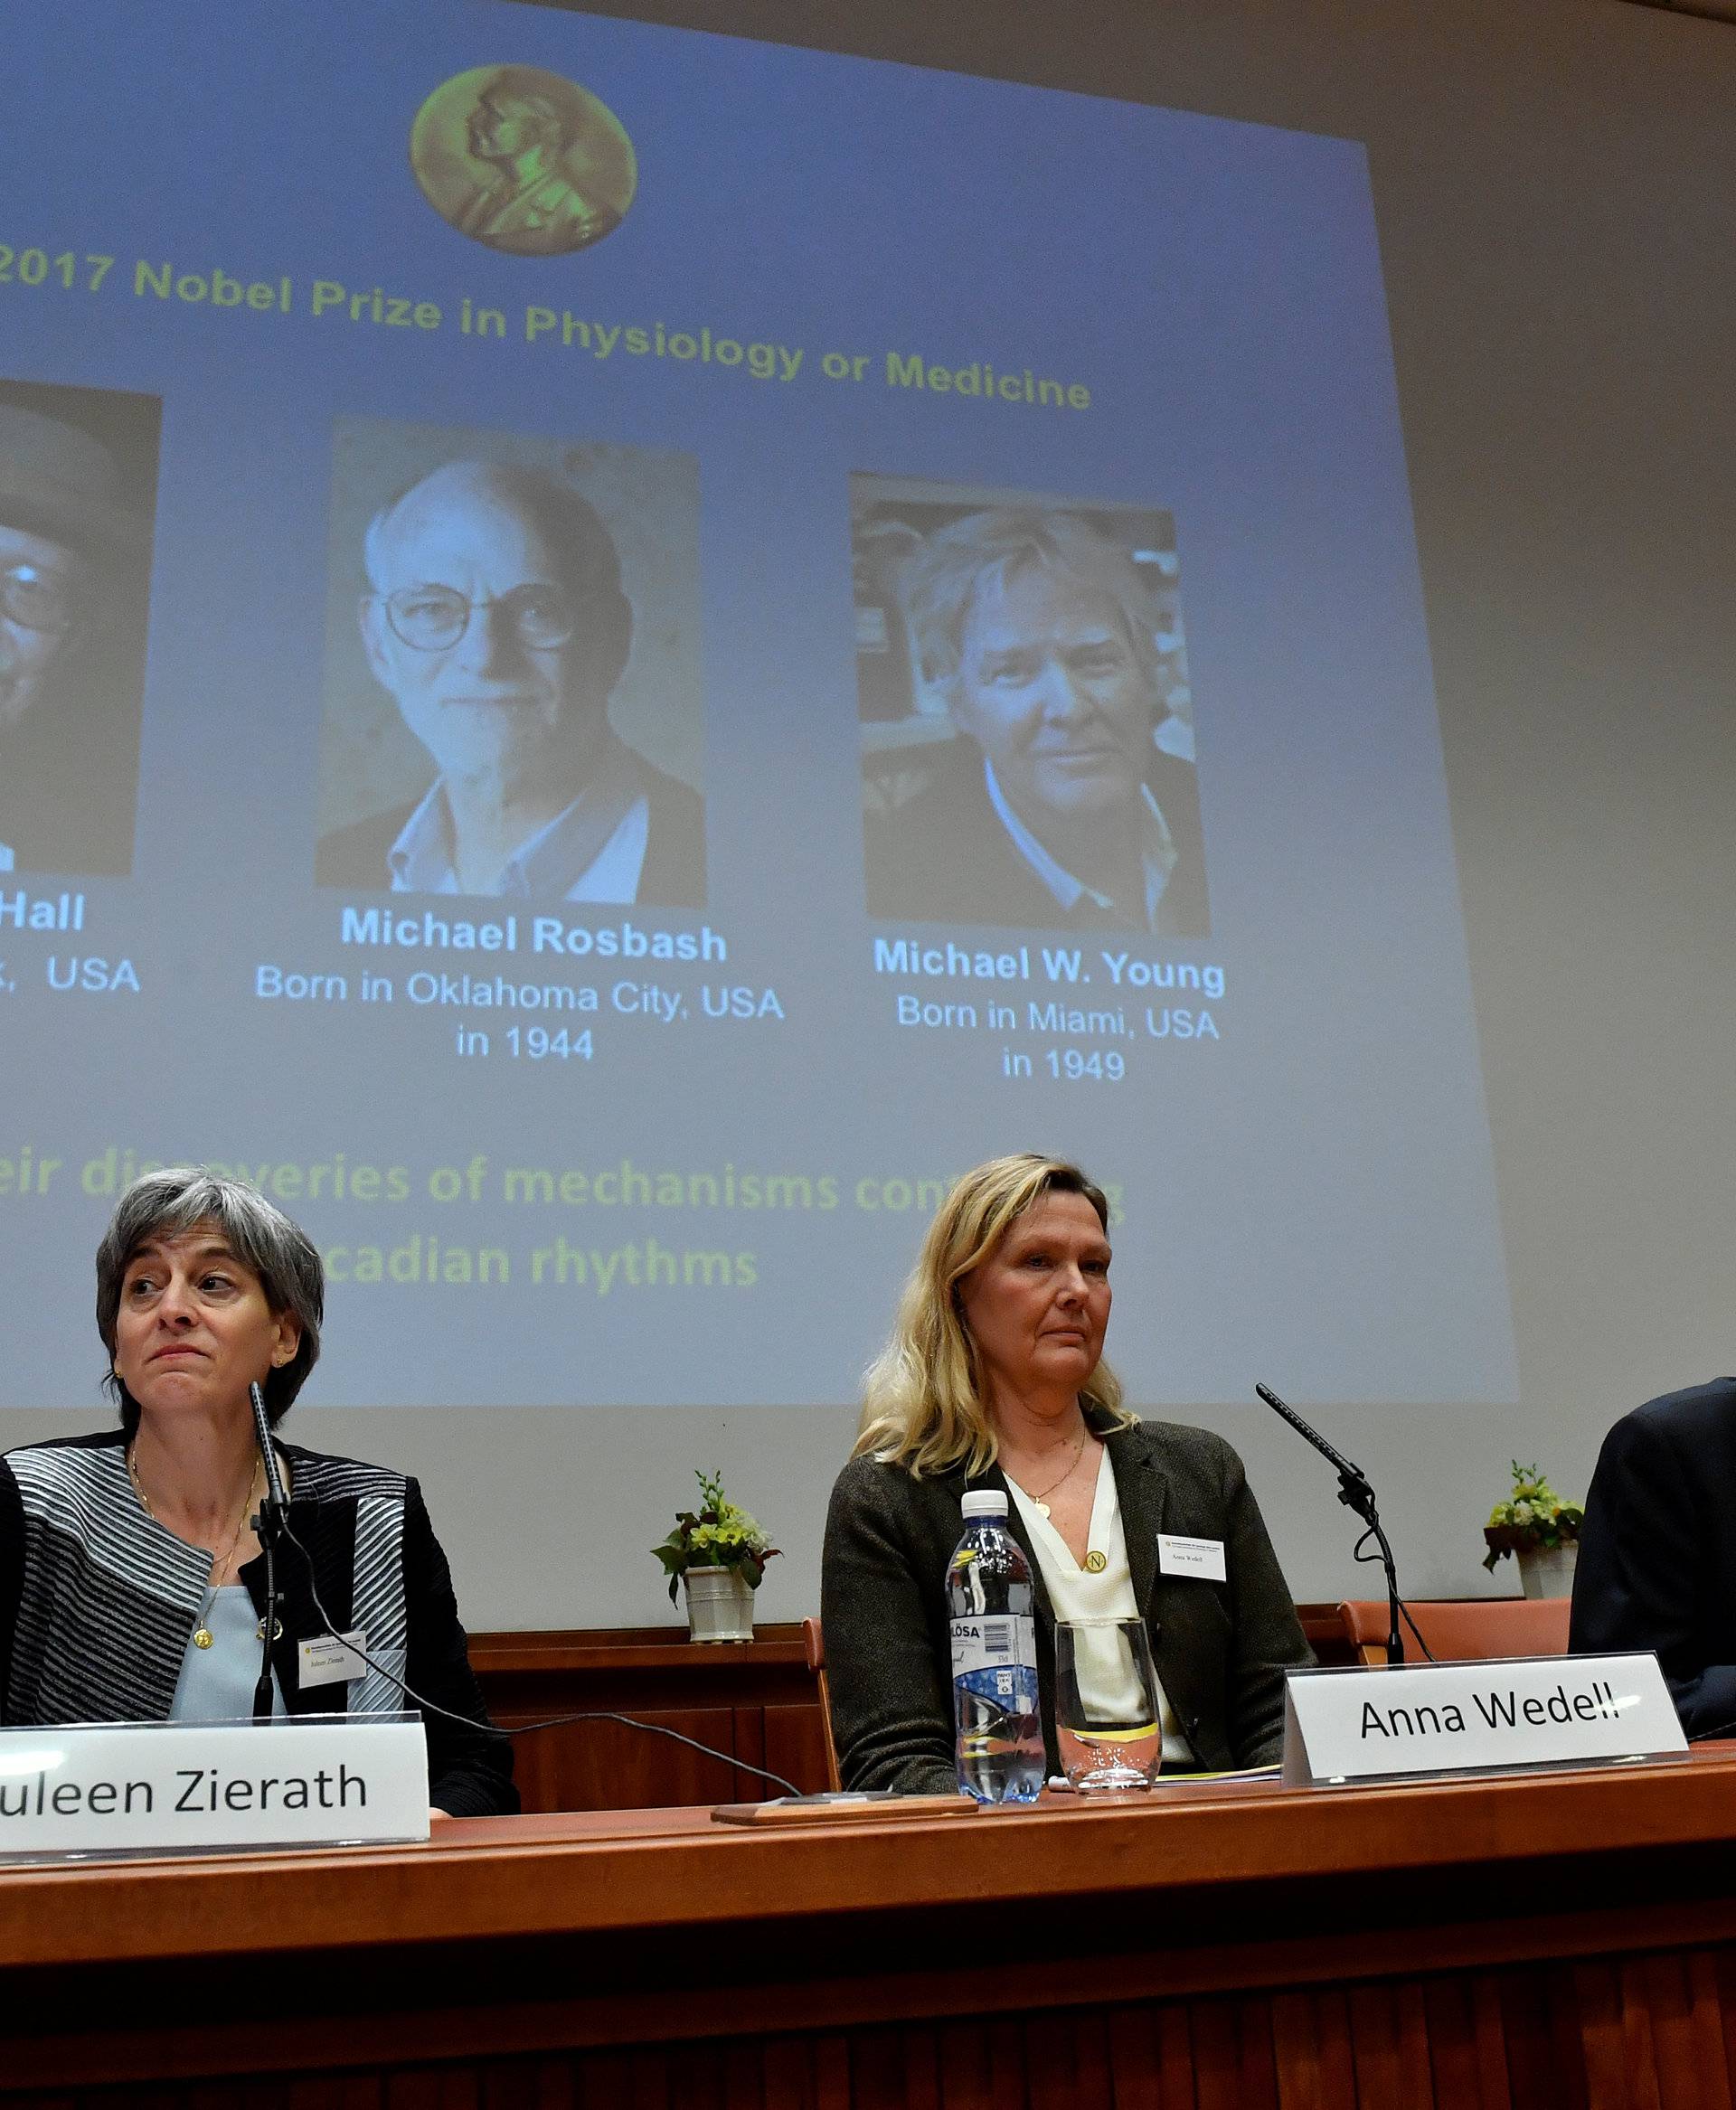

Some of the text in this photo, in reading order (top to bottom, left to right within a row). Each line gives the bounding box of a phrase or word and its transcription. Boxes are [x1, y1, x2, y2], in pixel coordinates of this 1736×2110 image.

[134, 259, 291, 313] Nobel
[312, 280, 441, 329] Prize
[461, 297, 506, 339] in
[524, 304, 804, 382] Physiology
[822, 351, 870, 381] or
[887, 352, 1090, 410] Medicine
[0, 890, 85, 931] Hall
[341, 906, 727, 961] Michael Rosbash
[47, 956, 141, 993] USA
[255, 964, 785, 1022] Born in Oklahoma City, USA
[873, 938, 1226, 999] Michael W. Young
[456, 1024, 595, 1060] in 1944
[897, 994, 1220, 1041] Born in Miami, USA
[1002, 1046, 1126, 1081] in 1949
[430, 1155, 488, 1203] of
[504, 1160, 840, 1211] mechanisms
[316, 1233, 760, 1298] cadian rhythms
[1361, 1681, 1620, 1738] Anna Wedell
[175, 1764, 366, 1813] Zierath
